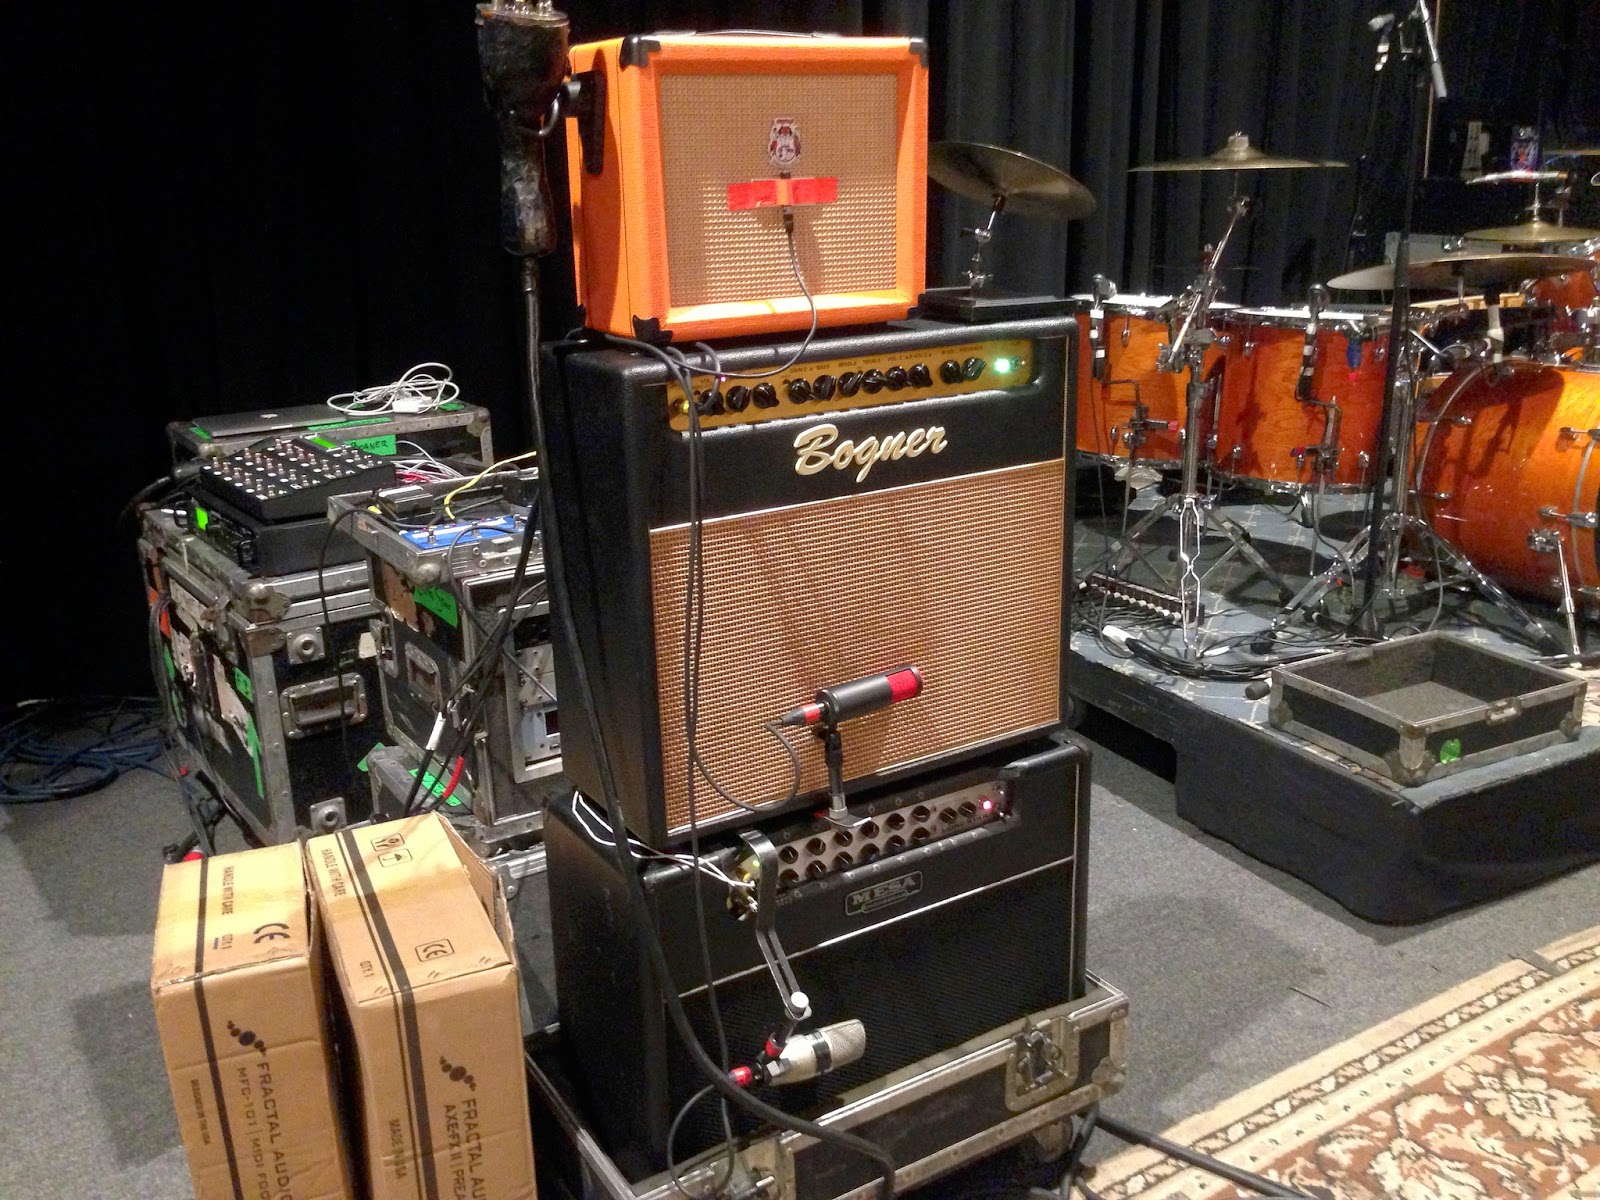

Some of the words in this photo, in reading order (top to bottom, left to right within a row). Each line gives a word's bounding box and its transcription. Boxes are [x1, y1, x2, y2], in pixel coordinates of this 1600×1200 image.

[793, 423, 948, 483] Bogner
[332, 881, 347, 897] CARE
[852, 876, 916, 905] MESA
[257, 1062, 282, 1144] FRACTAL
[461, 1098, 483, 1173] FRACTAL
